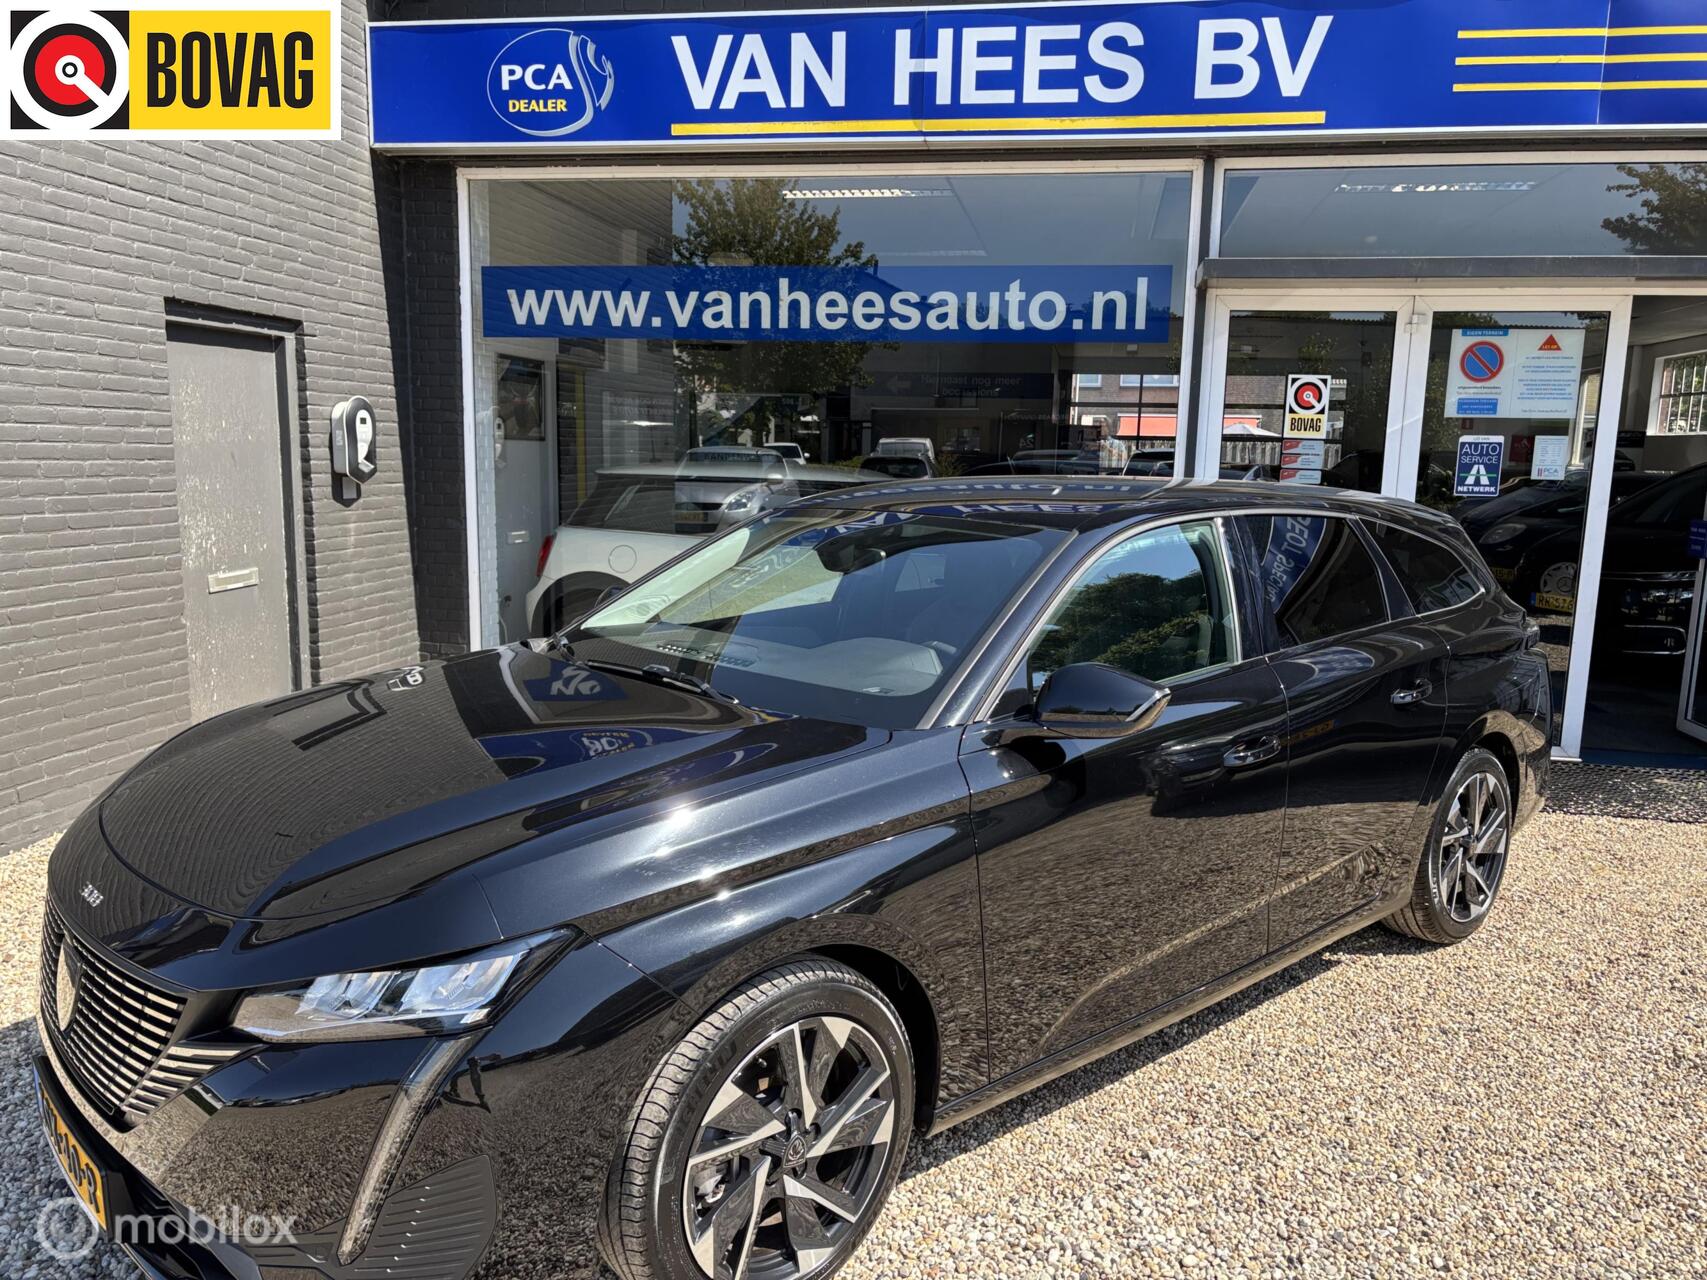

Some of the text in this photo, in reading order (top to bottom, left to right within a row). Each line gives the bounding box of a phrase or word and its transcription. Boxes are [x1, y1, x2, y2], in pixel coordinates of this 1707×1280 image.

[671, 15, 1334, 110] VAN HEES BV
[501, 63, 574, 91] PCA
[508, 98, 568, 113] DEALER
[506, 276, 1148, 331] www.vanheesauto.nl
[1289, 417, 1322, 433] BOVAG
[1461, 443, 1500, 455] AUTO
[1460, 455, 1499, 464] SERVICE
[1457, 485, 1496, 493] NETWERK
